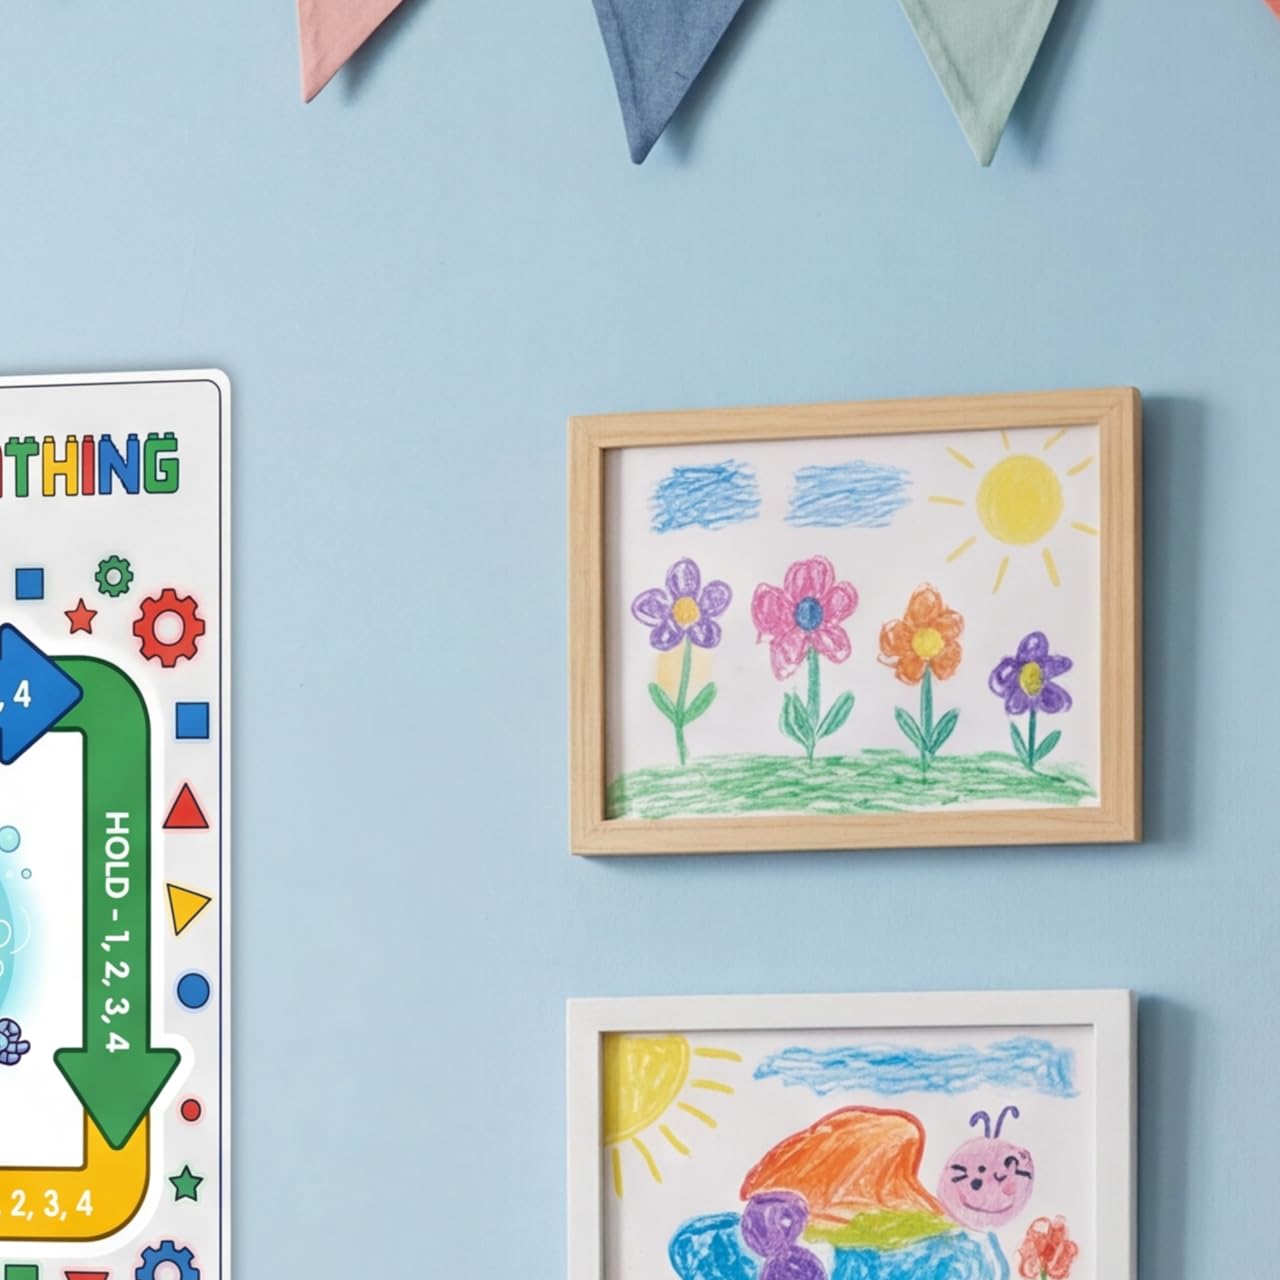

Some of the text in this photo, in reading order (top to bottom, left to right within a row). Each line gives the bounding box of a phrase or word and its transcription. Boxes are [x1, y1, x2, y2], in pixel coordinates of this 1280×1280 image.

[13, 680, 31, 708] 4
[105, 812, 130, 899] HOLD
[100, 931, 130, 952] 1,
[101, 961, 130, 986] 2,
[100, 998, 130, 1024] 3,
[105, 1032, 130, 1053] 4
[11, 1190, 34, 1221] 2,
[44, 1190, 67, 1221] 3,
[76, 1190, 93, 1216] 4
